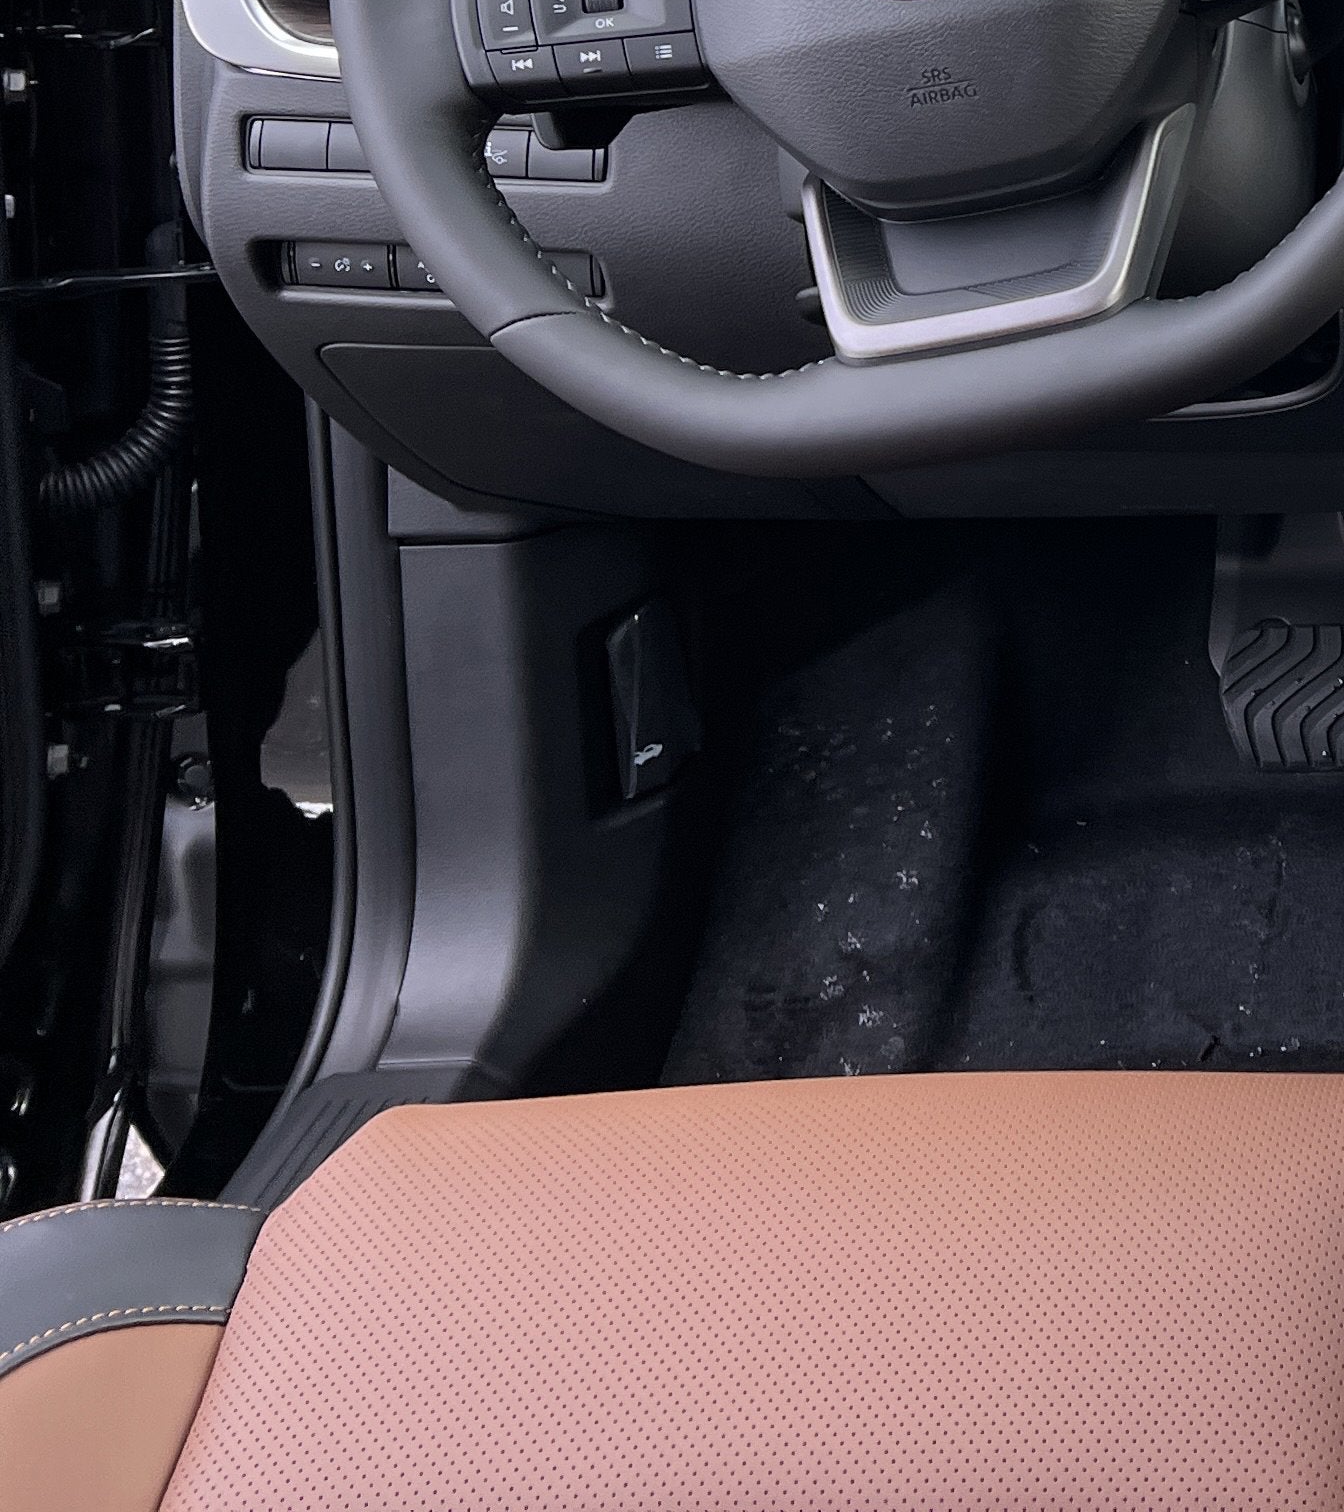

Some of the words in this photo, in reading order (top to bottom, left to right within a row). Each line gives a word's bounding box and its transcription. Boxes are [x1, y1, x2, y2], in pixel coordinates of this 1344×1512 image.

[595, 17, 614, 29] OK
[921, 67, 952, 85] SRS
[908, 83, 978, 108] AIRBAG
